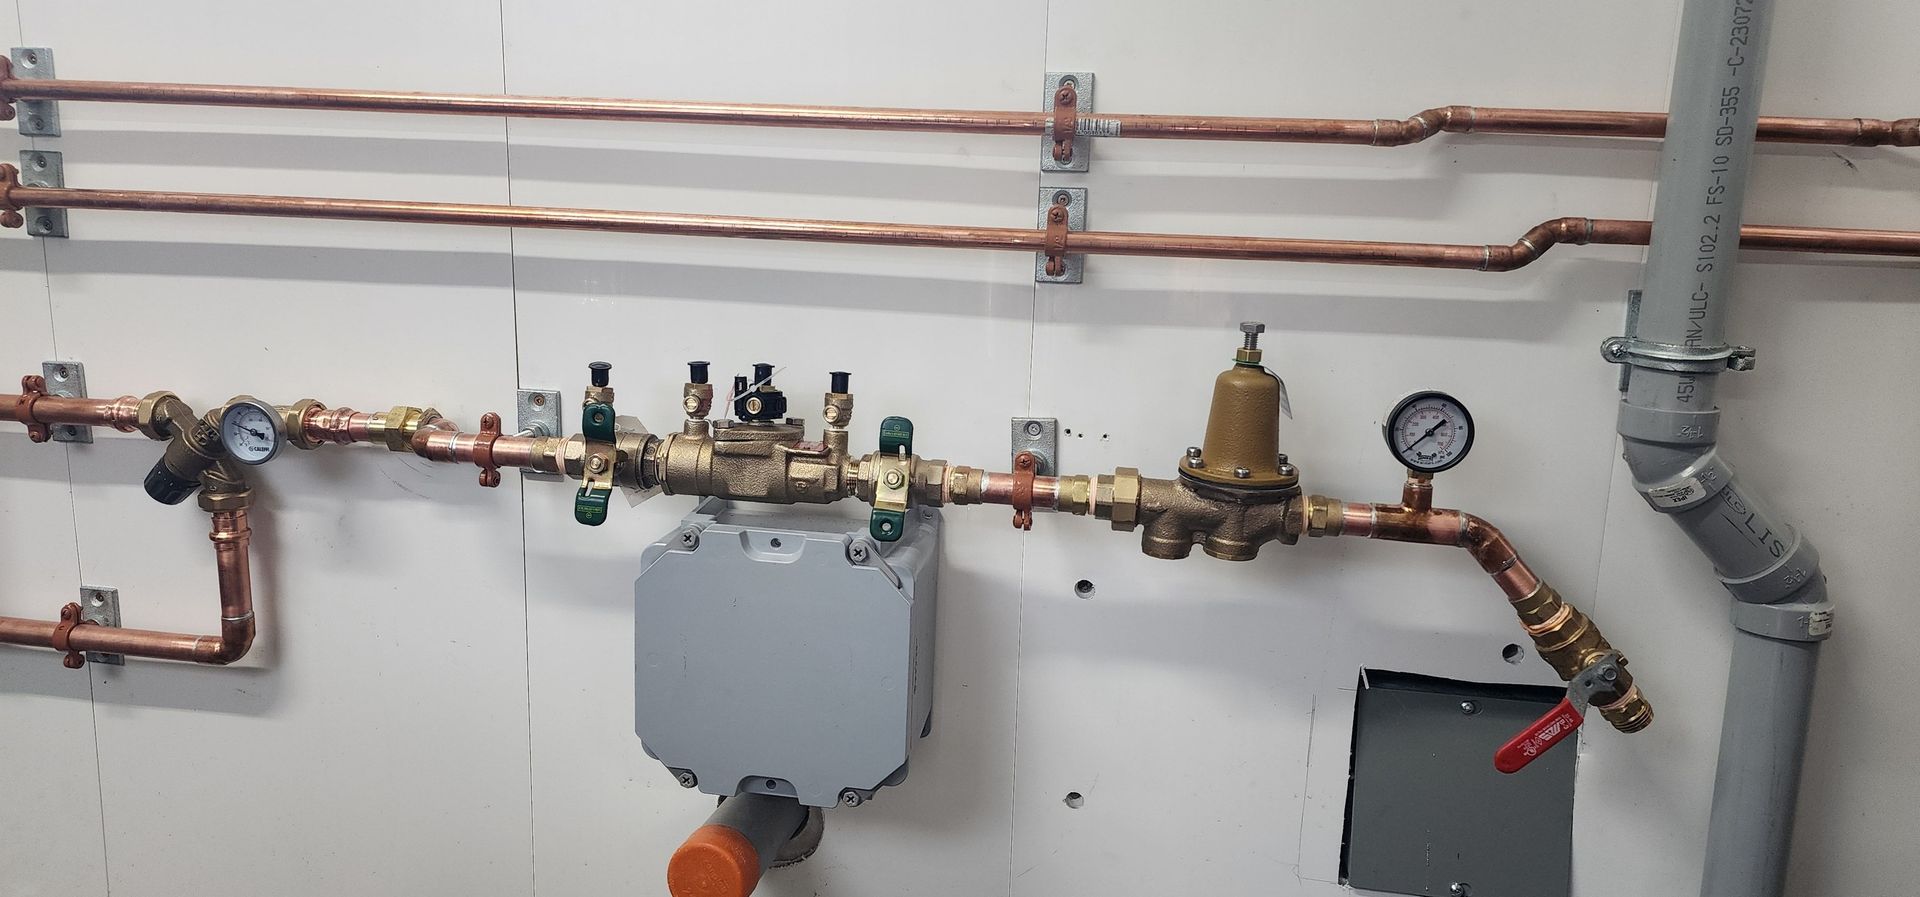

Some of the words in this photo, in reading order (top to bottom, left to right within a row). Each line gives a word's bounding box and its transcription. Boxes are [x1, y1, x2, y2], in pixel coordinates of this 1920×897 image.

[1715, 87, 1740, 146] SD-355
[1705, 156, 1730, 205] FS-10
[1696, 214, 1721, 272] S102.2
[1684, 282, 1709, 347] AN/ULC-
